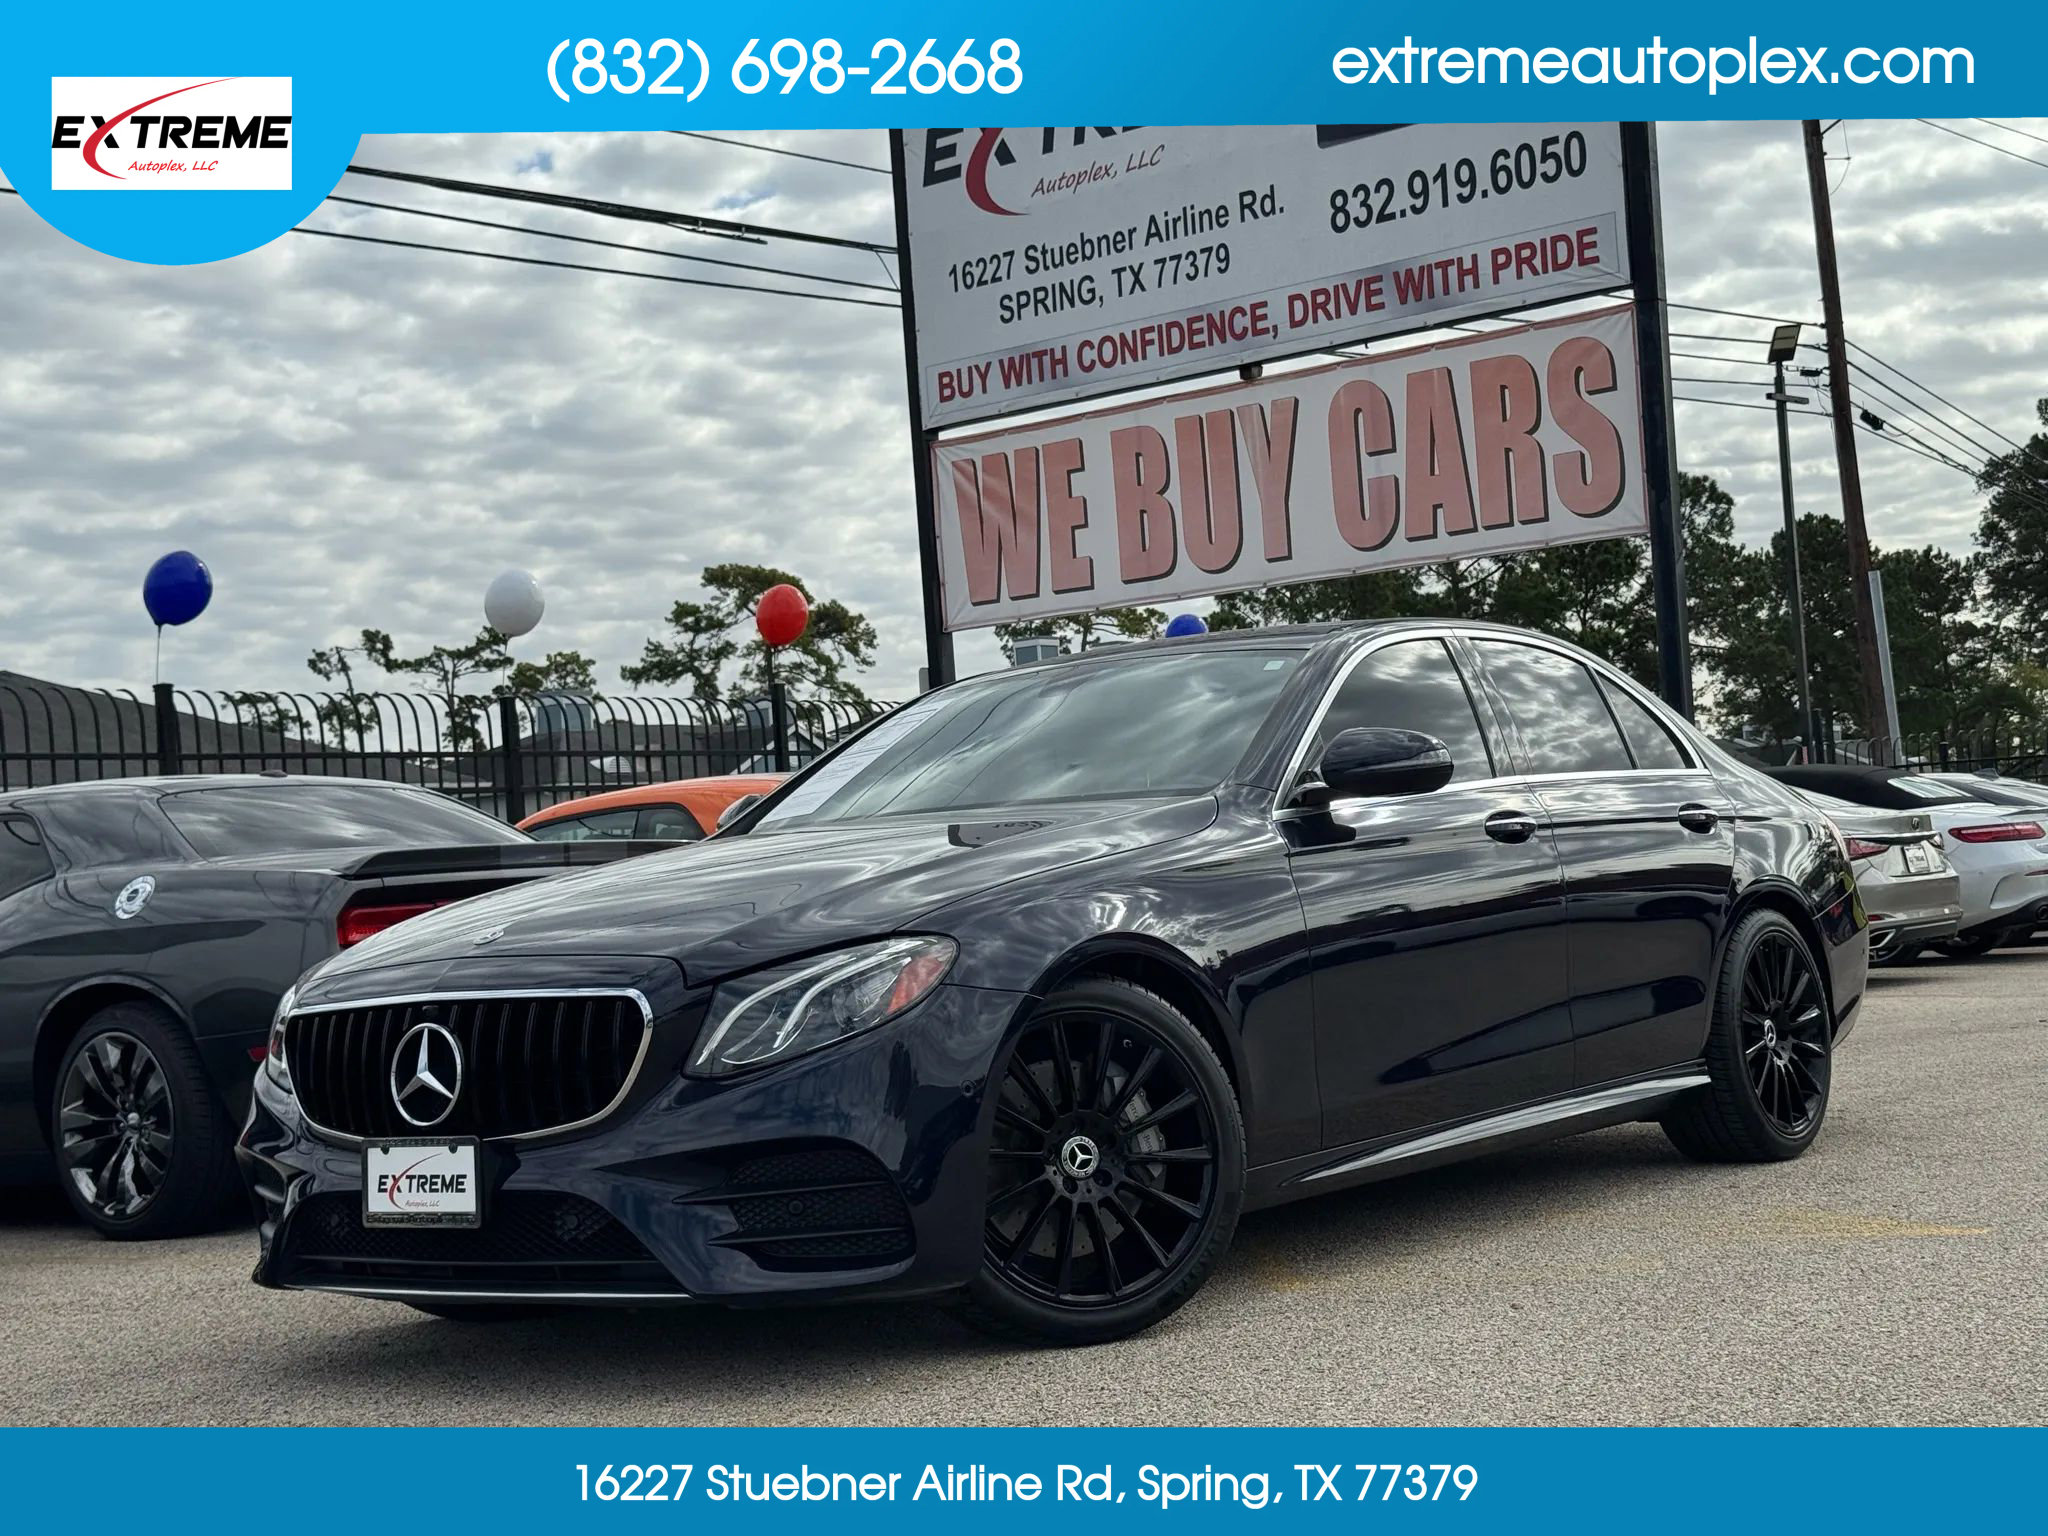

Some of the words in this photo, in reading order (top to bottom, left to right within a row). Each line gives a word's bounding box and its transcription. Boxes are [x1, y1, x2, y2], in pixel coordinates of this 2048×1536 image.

[1031, 160, 1117, 197] Autoplex,
[1125, 144, 1165, 174] LLC
[1329, 130, 1587, 234] 832.919.6050
[949, 251, 1015, 292] 16227
[1024, 226, 1137, 275] Stuebner
[1144, 203, 1230, 247] Airline
[1238, 184, 1285, 223] Rd.
[1000, 275, 1104, 324] SPRING,
[1111, 262, 1147, 298] TX
[1153, 243, 1231, 289] 77379
[937, 361, 992, 403] BUY
[999, 345, 1069, 389] WITH
[1076, 301, 1279, 373] CONFIDENCE,
[1288, 274, 1386, 329] DRIVE
[1392, 253, 1480, 306] WITH
[1491, 226, 1600, 286] PRIDE
[952, 438, 1095, 606] WE
[1109, 396, 1300, 585] BUY
[1328, 336, 1626, 552] CARS
[377, 1174, 468, 1194] EXTREME
